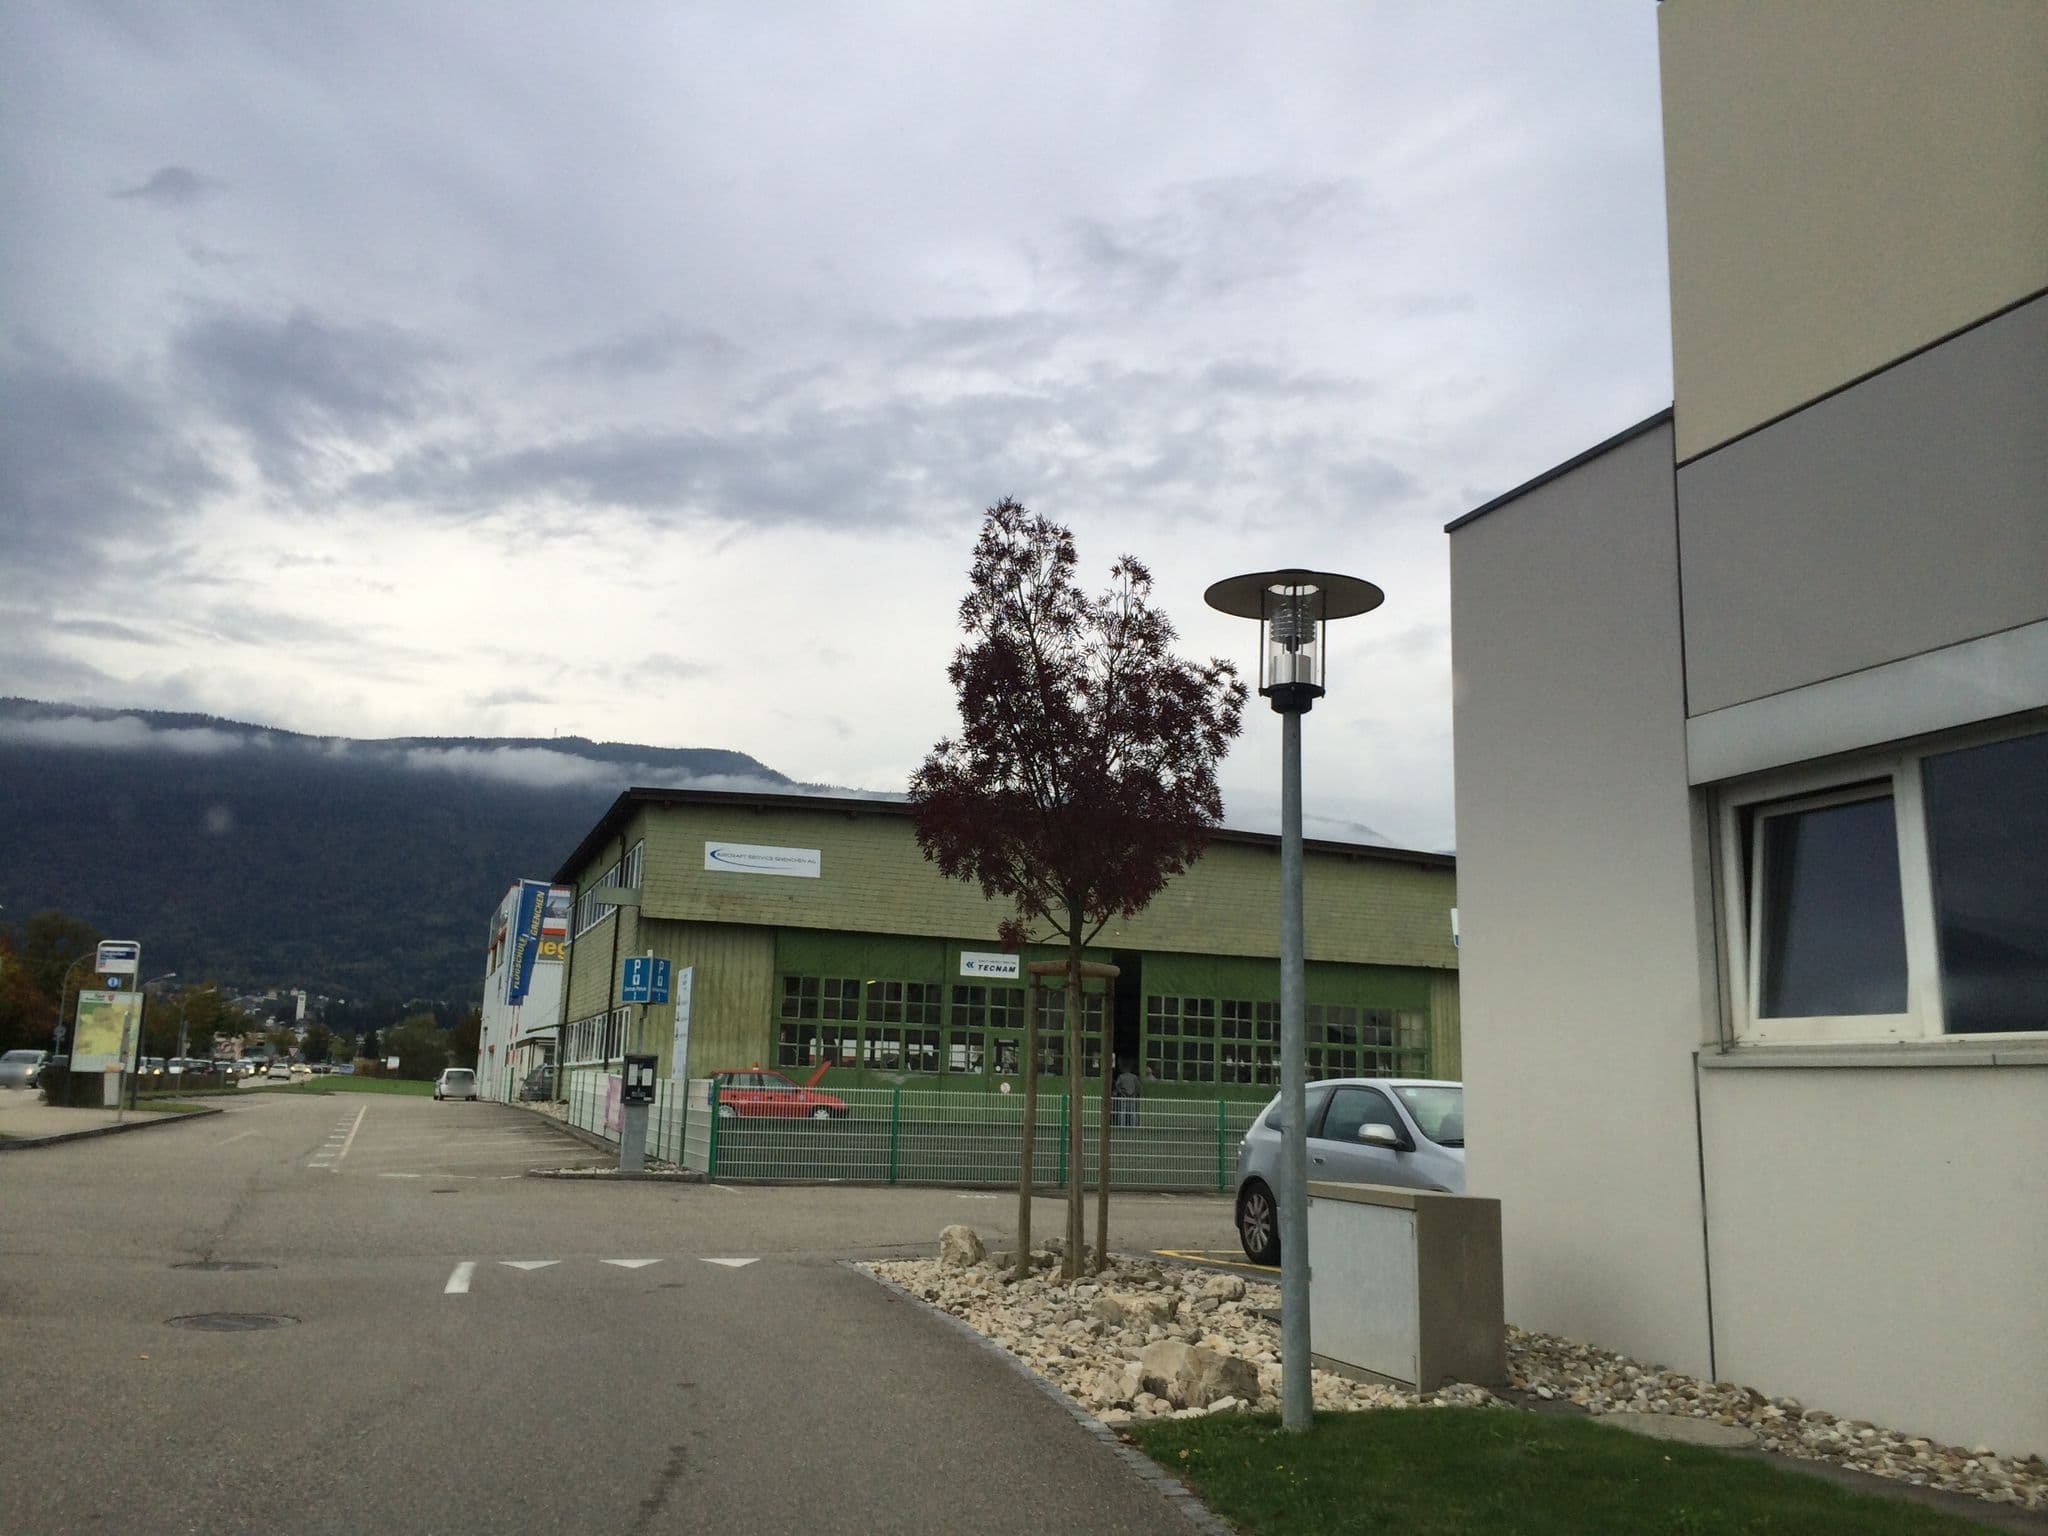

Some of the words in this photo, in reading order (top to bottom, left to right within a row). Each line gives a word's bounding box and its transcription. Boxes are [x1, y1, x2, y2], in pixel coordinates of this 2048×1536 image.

[774, 856, 807, 864] GRENCHEN
[531, 891, 545, 936] GRENCHEN
[511, 936, 528, 989] FLUGSCHULE
[634, 959, 641, 974] P
[978, 964, 1016, 973] TECNAM
